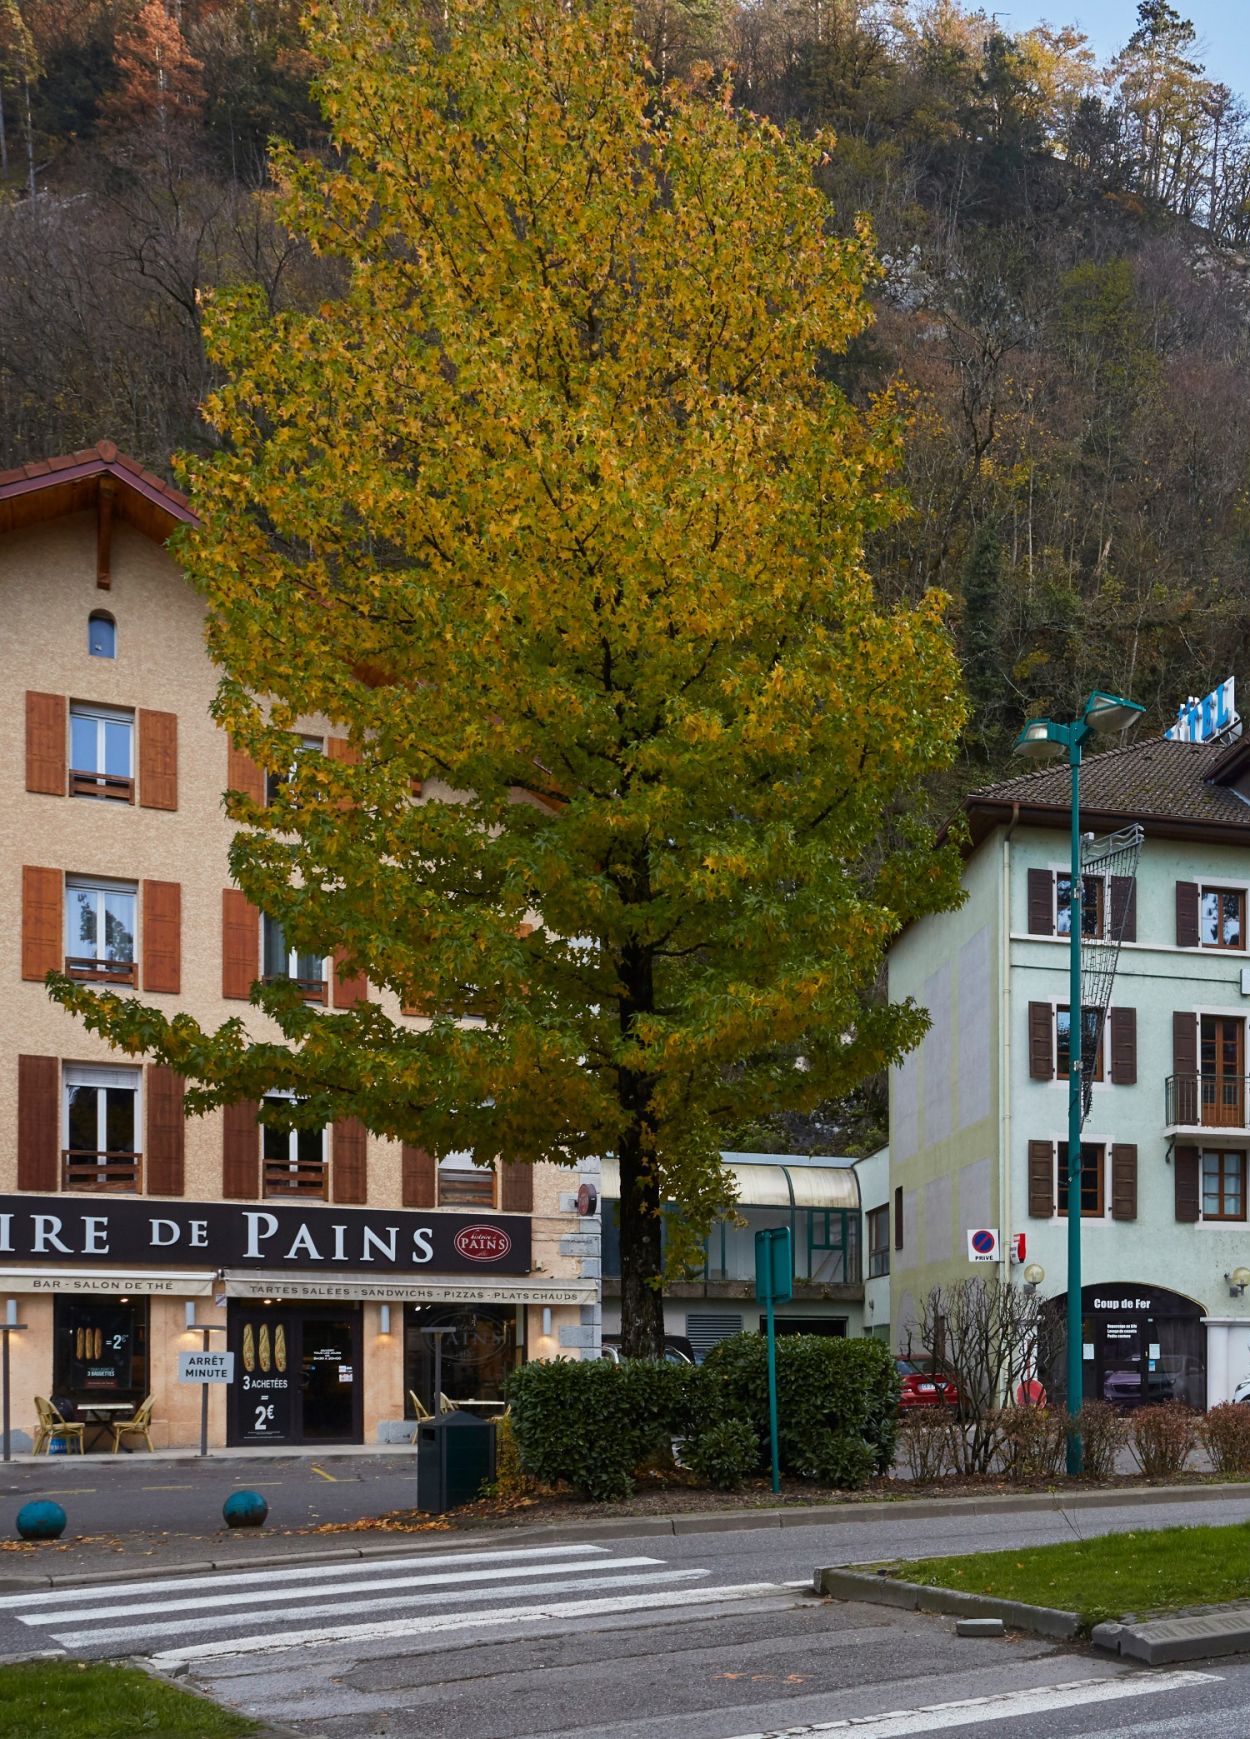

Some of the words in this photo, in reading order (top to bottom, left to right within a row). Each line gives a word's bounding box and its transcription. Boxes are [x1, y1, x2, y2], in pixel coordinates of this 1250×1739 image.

[149, 1218, 209, 1247] DE
[241, 1211, 434, 1263] PAINS
[460, 1237, 505, 1250] PAINS
[33, 1280, 61, 1288] BAR
[74, 1281, 120, 1289] SALON
[125, 1281, 142, 1290] DE
[147, 1280, 173, 1290] THÉ
[250, 1286, 298, 1295] TARTES
[361, 1289, 433, 1298] SANDWICHS
[444, 1291, 484, 1299] PIZZAS
[494, 1292, 529, 1300] PLATS
[533, 1293, 578, 1301] CHAUDS
[1094, 1298, 1119, 1309] Coup
[1121, 1298, 1133, 1309] de
[1135, 1298, 1151, 1309] Fer
[188, 1355, 225, 1366] ARRÊT
[185, 1368, 228, 1378] MINUTE
[242, 1375, 250, 1390] 3
[251, 1378, 288, 1389] ACHETÉES
[254, 1404, 275, 1430] 2€
